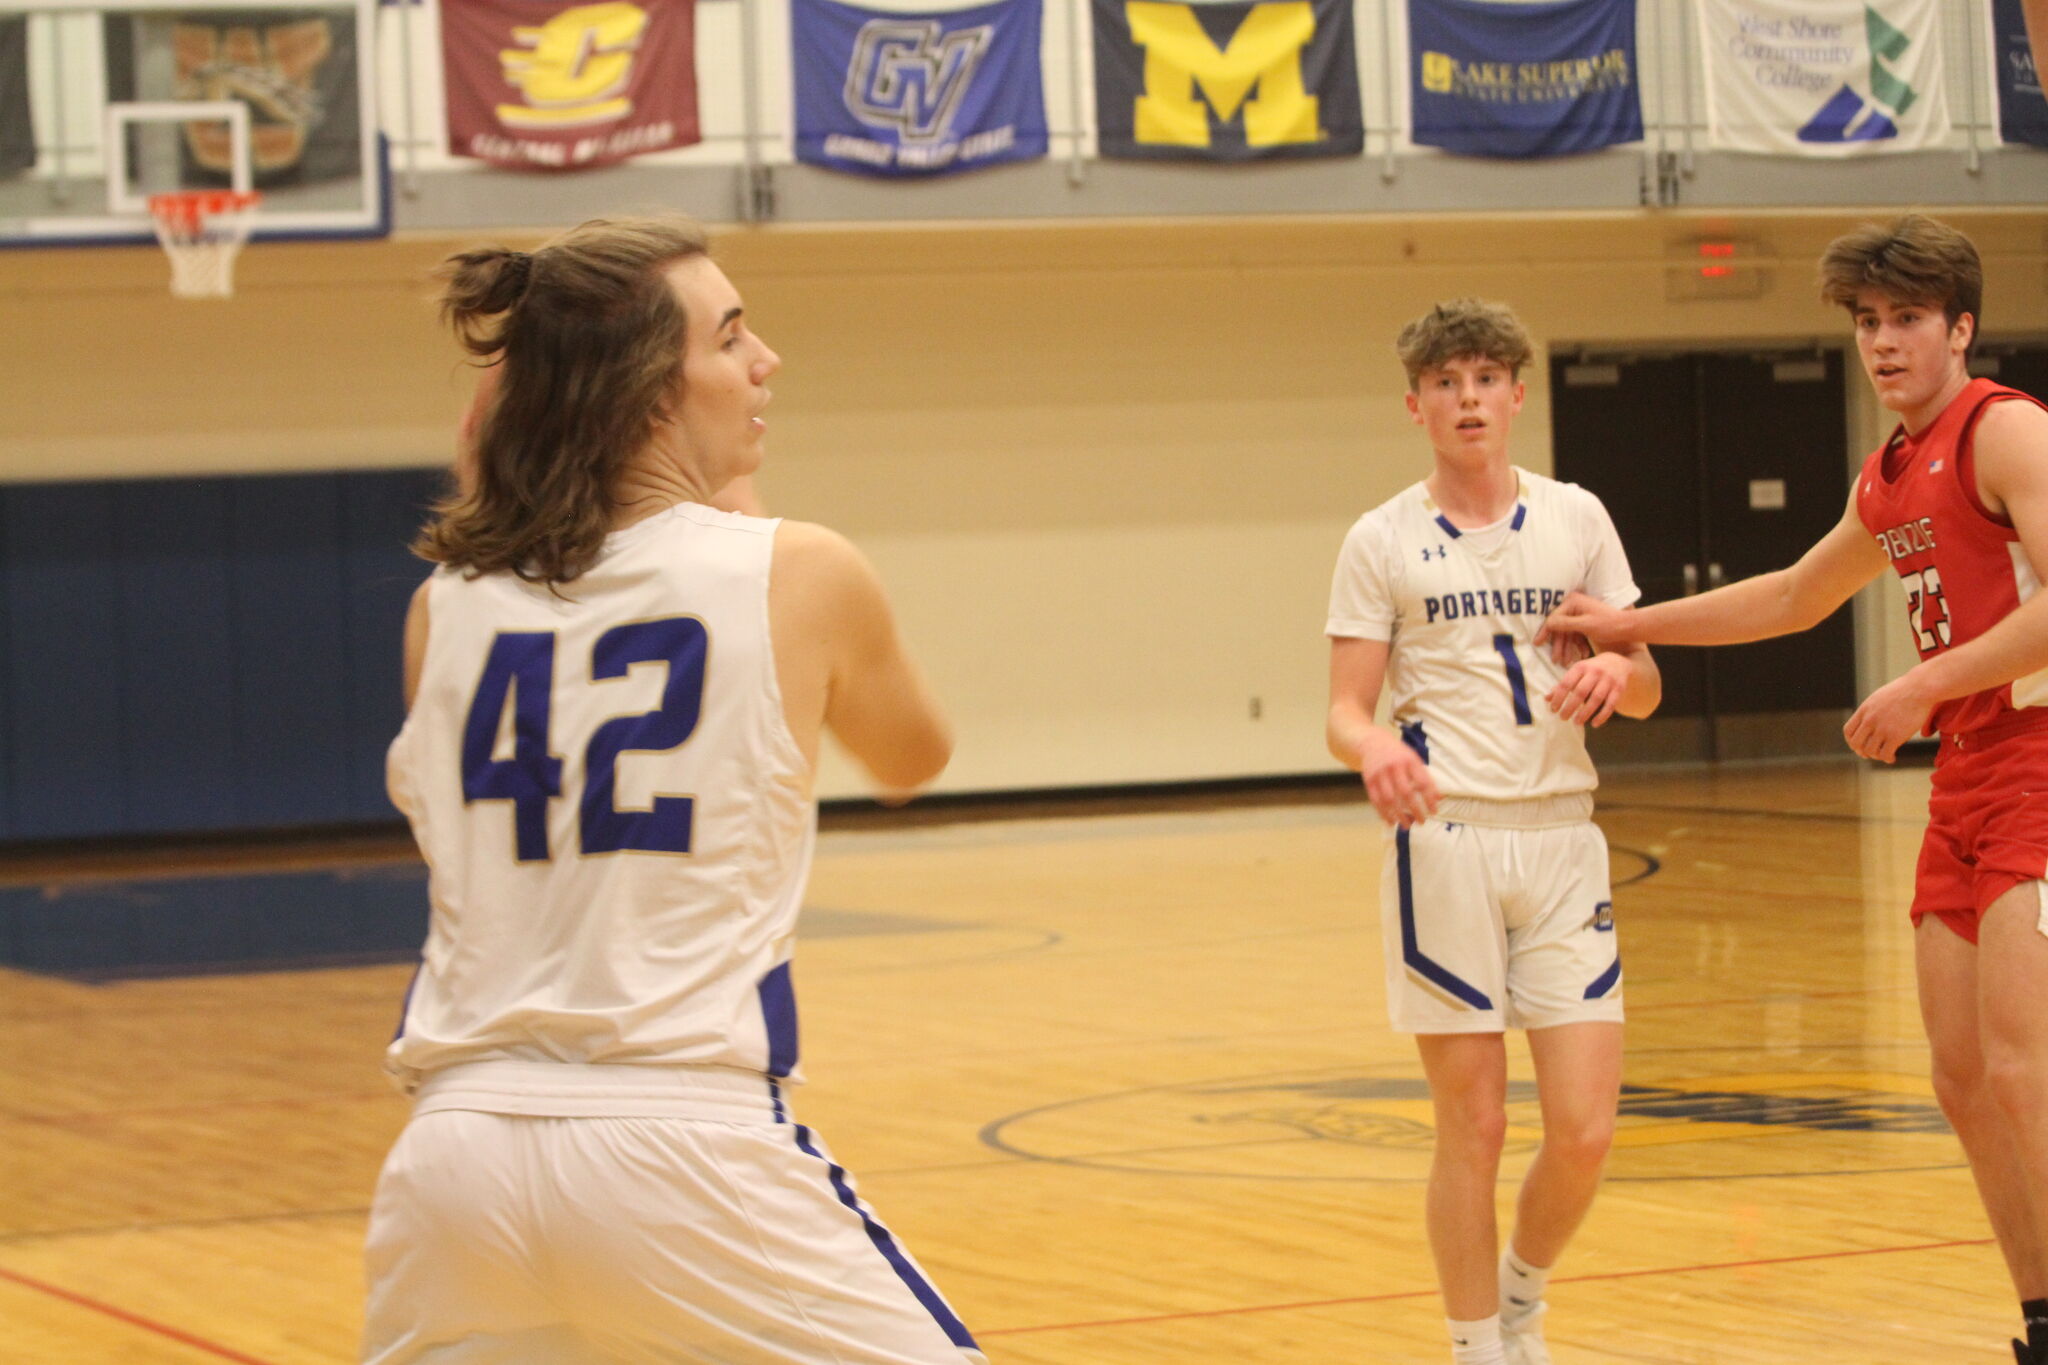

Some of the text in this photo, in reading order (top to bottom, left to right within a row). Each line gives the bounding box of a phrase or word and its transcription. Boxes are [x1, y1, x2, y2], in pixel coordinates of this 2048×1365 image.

[1728, 35, 1856, 64] Community
[1788, 16, 1842, 39] Shore
[1124, 1, 1321, 148] M
[1450, 58, 1512, 86] LAKE
[1755, 62, 1833, 92] College
[1900, 565, 1952, 652] 23
[1493, 632, 1532, 726] 1
[460, 612, 711, 866] 42
